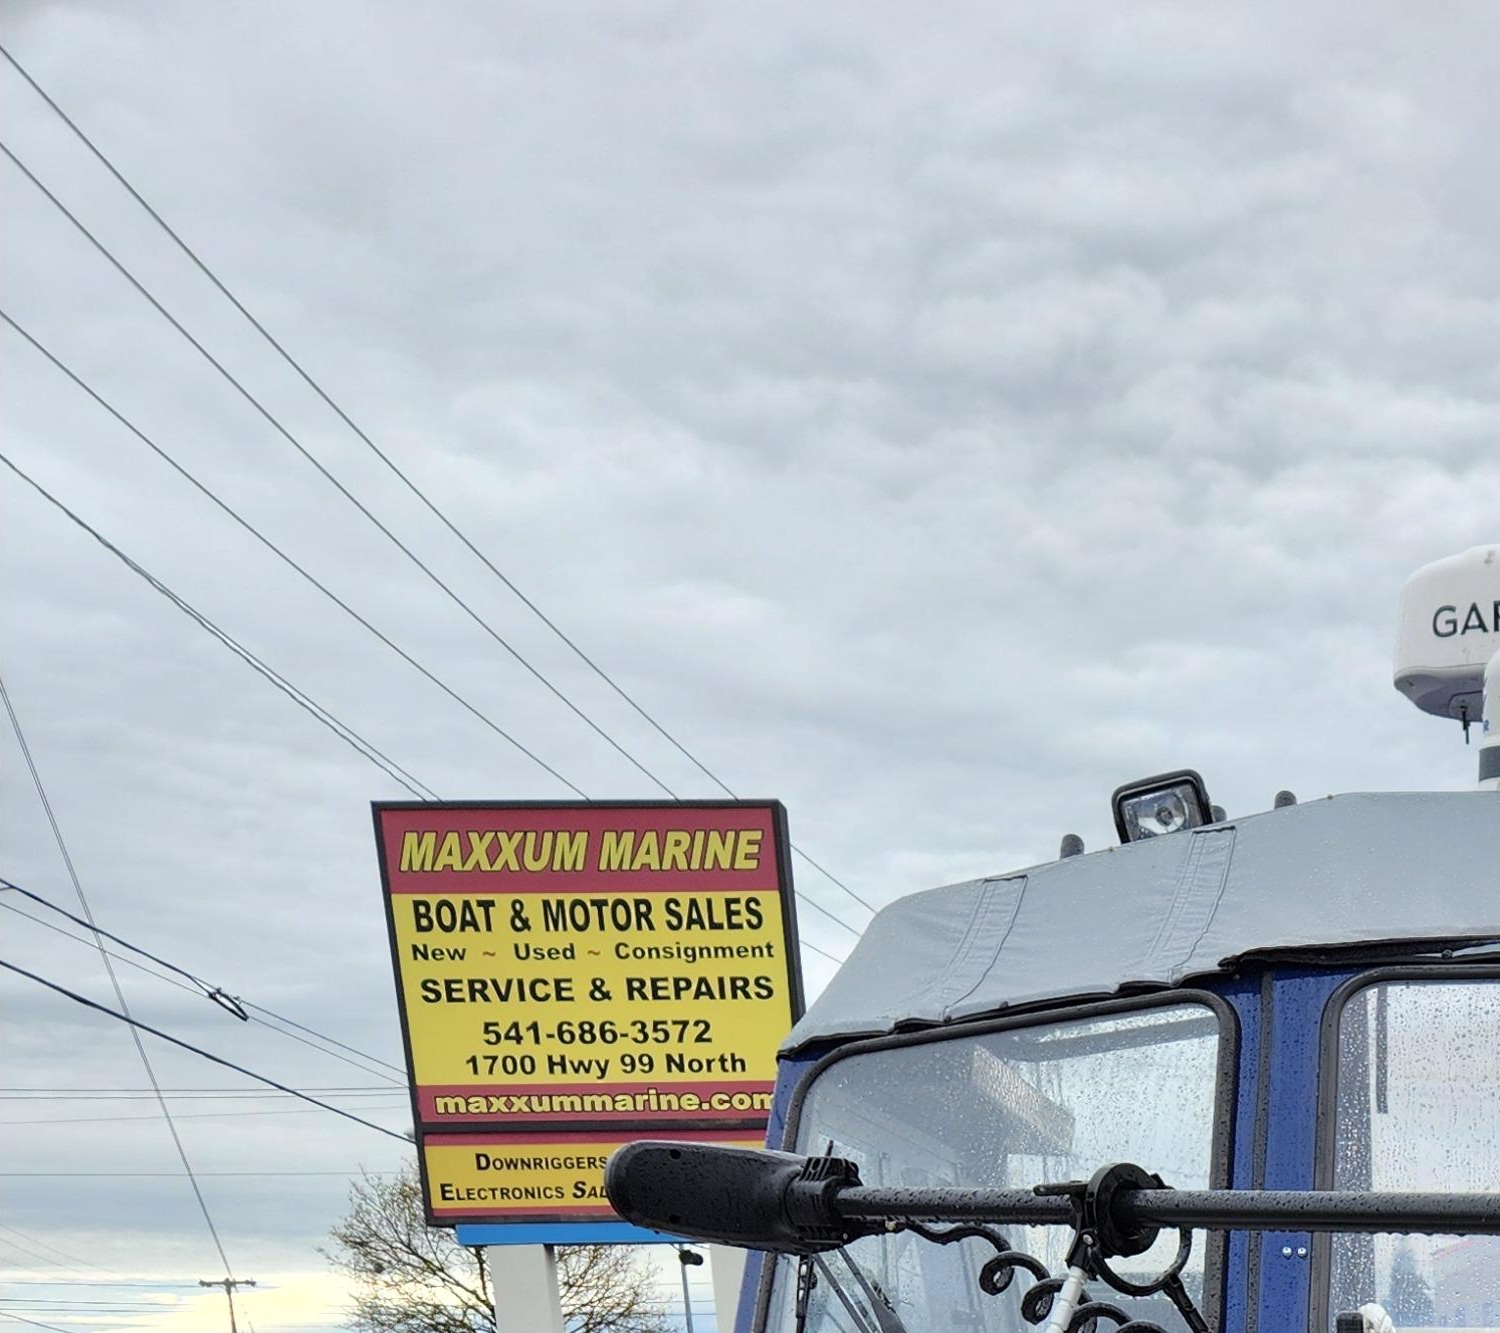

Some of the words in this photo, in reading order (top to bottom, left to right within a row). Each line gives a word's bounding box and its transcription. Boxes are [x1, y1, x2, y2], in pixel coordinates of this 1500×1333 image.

[400, 830, 589, 872] MAXXUM
[598, 829, 764, 871] MARINE
[412, 899, 496, 932] BOAT
[510, 899, 532, 932] &
[542, 898, 656, 932] MOTOR
[664, 897, 764, 931] SALES
[411, 943, 467, 961] New
[513, 943, 576, 961] Used
[614, 941, 775, 963] Consignment
[420, 977, 575, 1003] SERVICE
[589, 977, 612, 1002] &
[626, 976, 774, 1001] REPAIRS
[482, 1019, 713, 1046] 541-686-3572
[465, 1054, 536, 1076] 1700
[547, 1054, 610, 1080] Hwy
[620, 1054, 655, 1075] 99
[665, 1052, 747, 1074] North
[440, 1183, 565, 1201] ELECTRONICS
[572, 1181, 610, 1199] SAL
